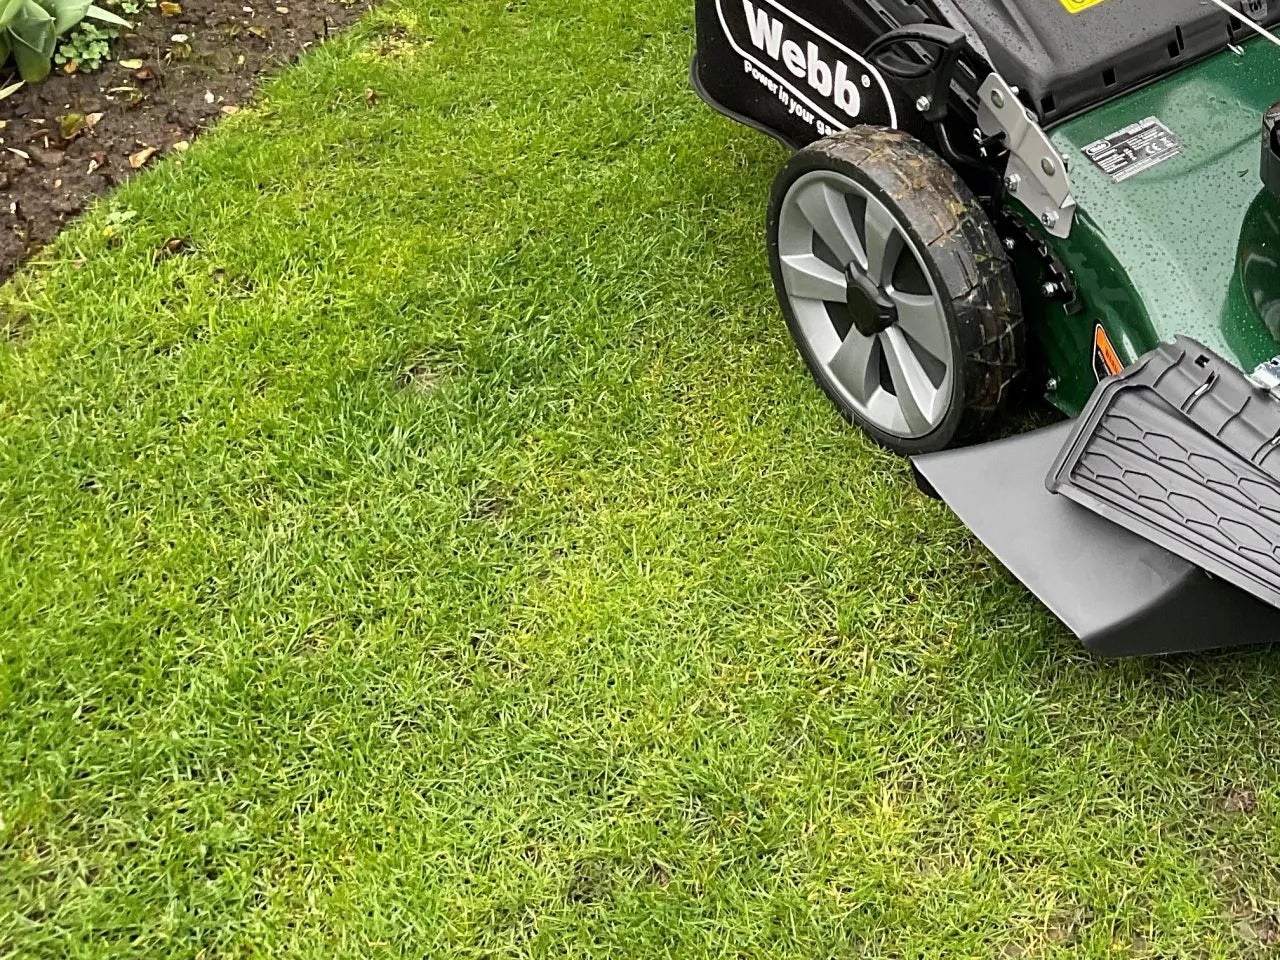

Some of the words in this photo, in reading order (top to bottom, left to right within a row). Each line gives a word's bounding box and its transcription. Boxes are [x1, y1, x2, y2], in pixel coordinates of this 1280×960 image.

[744, 59, 778, 95] Power
[778, 86, 789, 106] in
[789, 96, 815, 125] your
